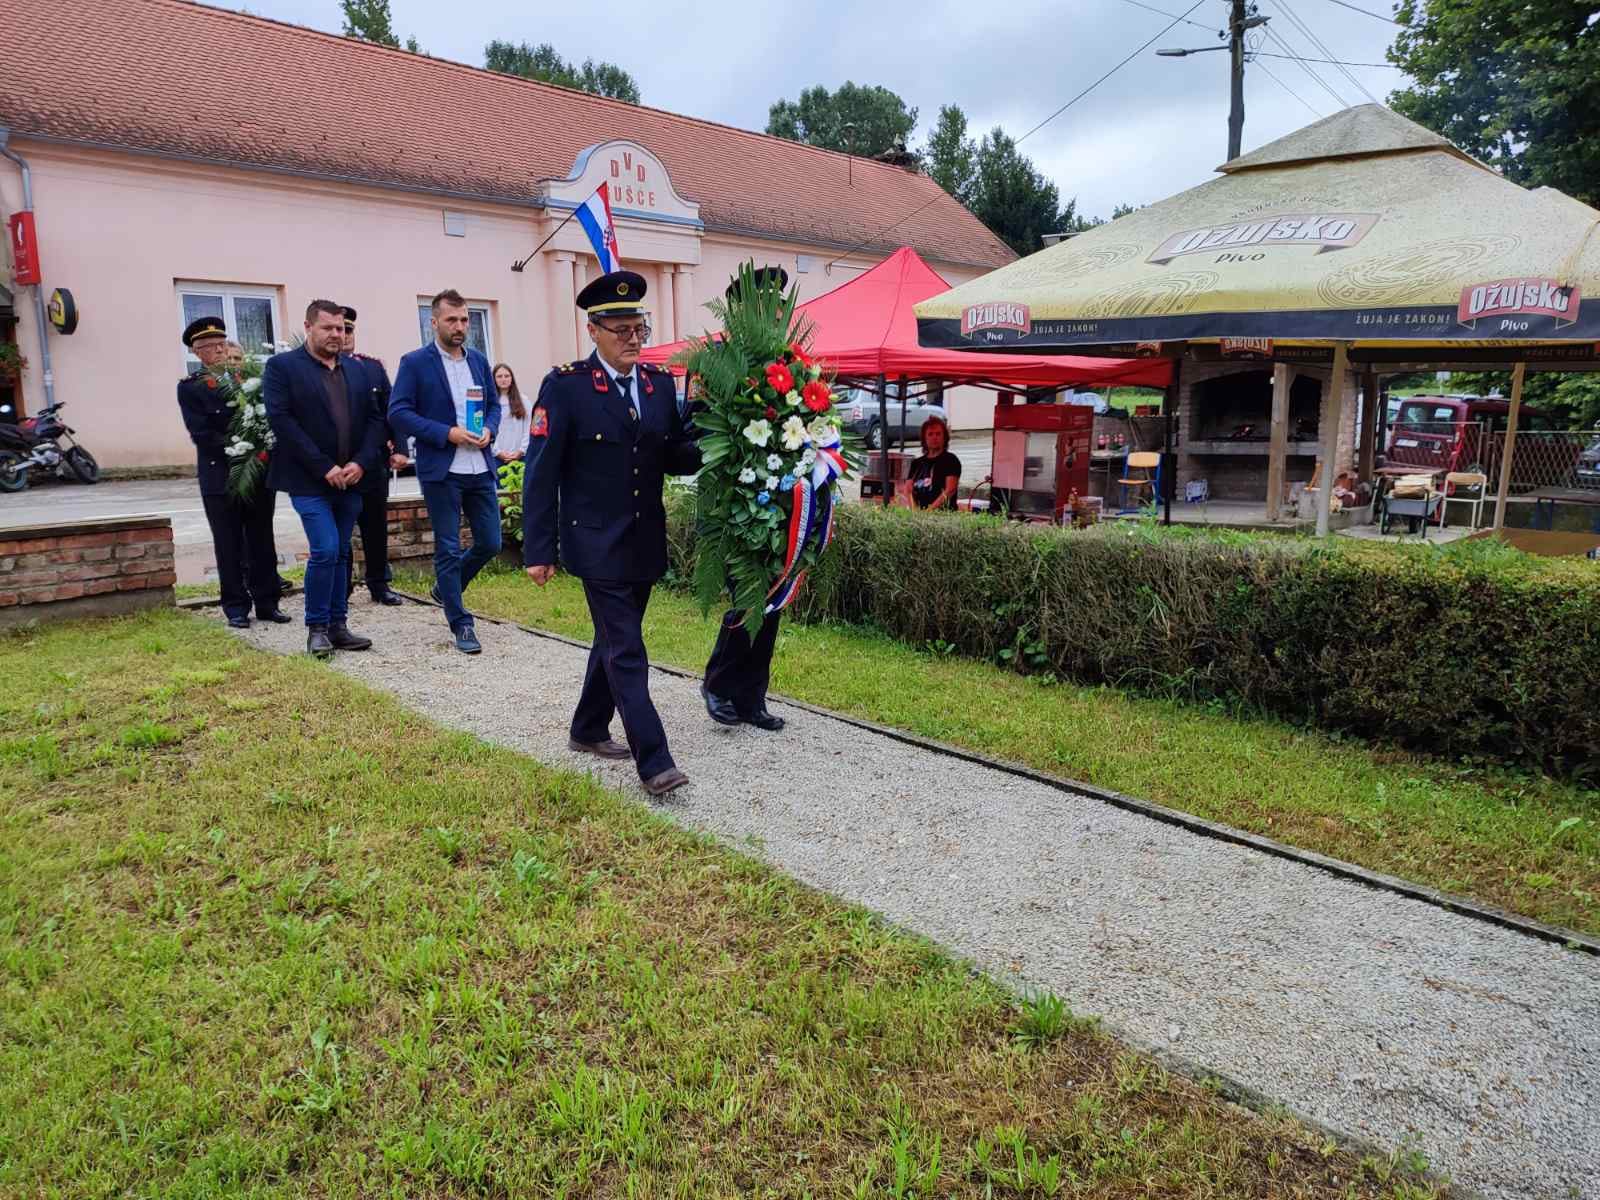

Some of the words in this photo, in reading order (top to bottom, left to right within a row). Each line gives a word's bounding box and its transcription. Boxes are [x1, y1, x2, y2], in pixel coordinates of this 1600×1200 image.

[610, 152, 646, 182] DVD
[967, 303, 1025, 329] Ožujsko
[1355, 313, 1383, 325] ŽUJA
[1387, 314, 1401, 324] JE
[1404, 313, 1451, 324] ZAKON!
